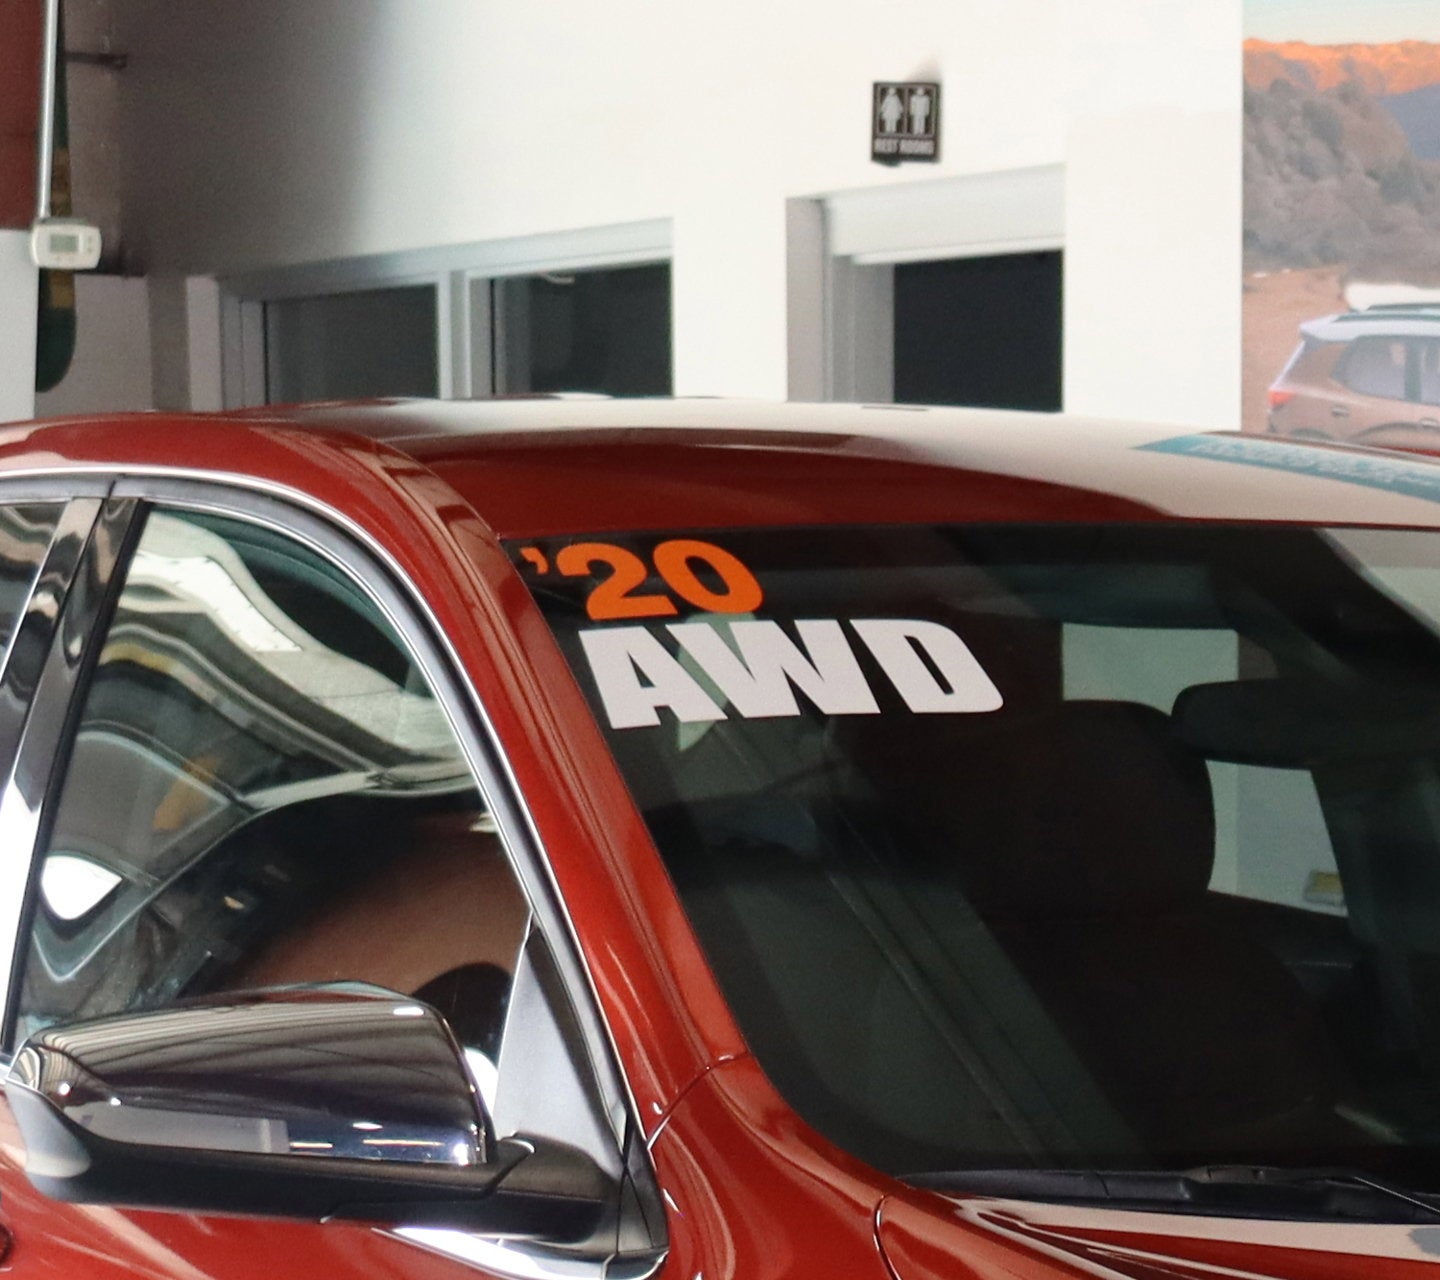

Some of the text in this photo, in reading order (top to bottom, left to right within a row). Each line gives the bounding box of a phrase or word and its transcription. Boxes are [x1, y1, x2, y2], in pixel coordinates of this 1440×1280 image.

[874, 137, 935, 155] REST ROOMS
[577, 617, 1005, 731] AWD
